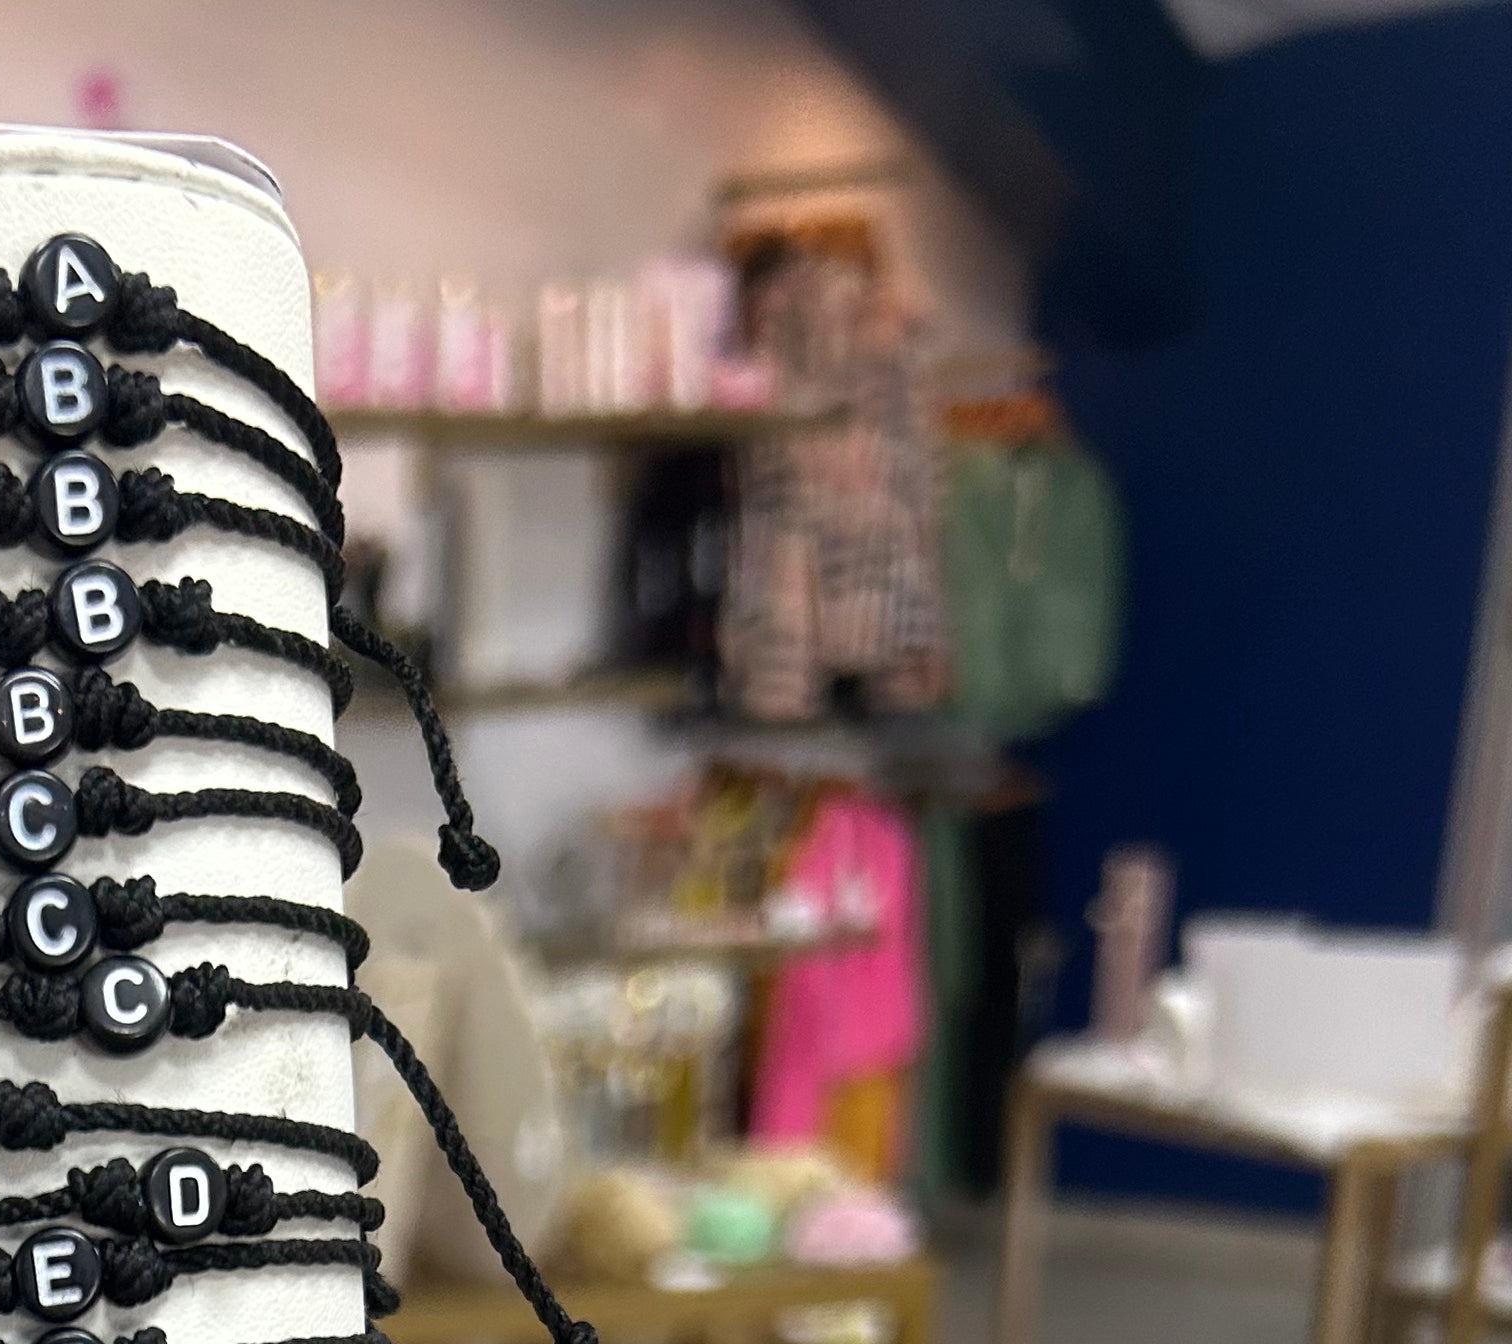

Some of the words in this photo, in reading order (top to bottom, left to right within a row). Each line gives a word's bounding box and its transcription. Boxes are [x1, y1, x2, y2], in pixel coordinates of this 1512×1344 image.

[56, 246, 104, 313] A
[40, 356, 93, 424] B
[54, 466, 103, 536] B
[72, 574, 124, 644] B
[11, 682, 54, 745] B
[9, 782, 56, 850] C
[26, 889, 77, 956] C
[102, 967, 147, 1024] C
[169, 1164, 208, 1226] D
[33, 1241, 83, 1307] E
